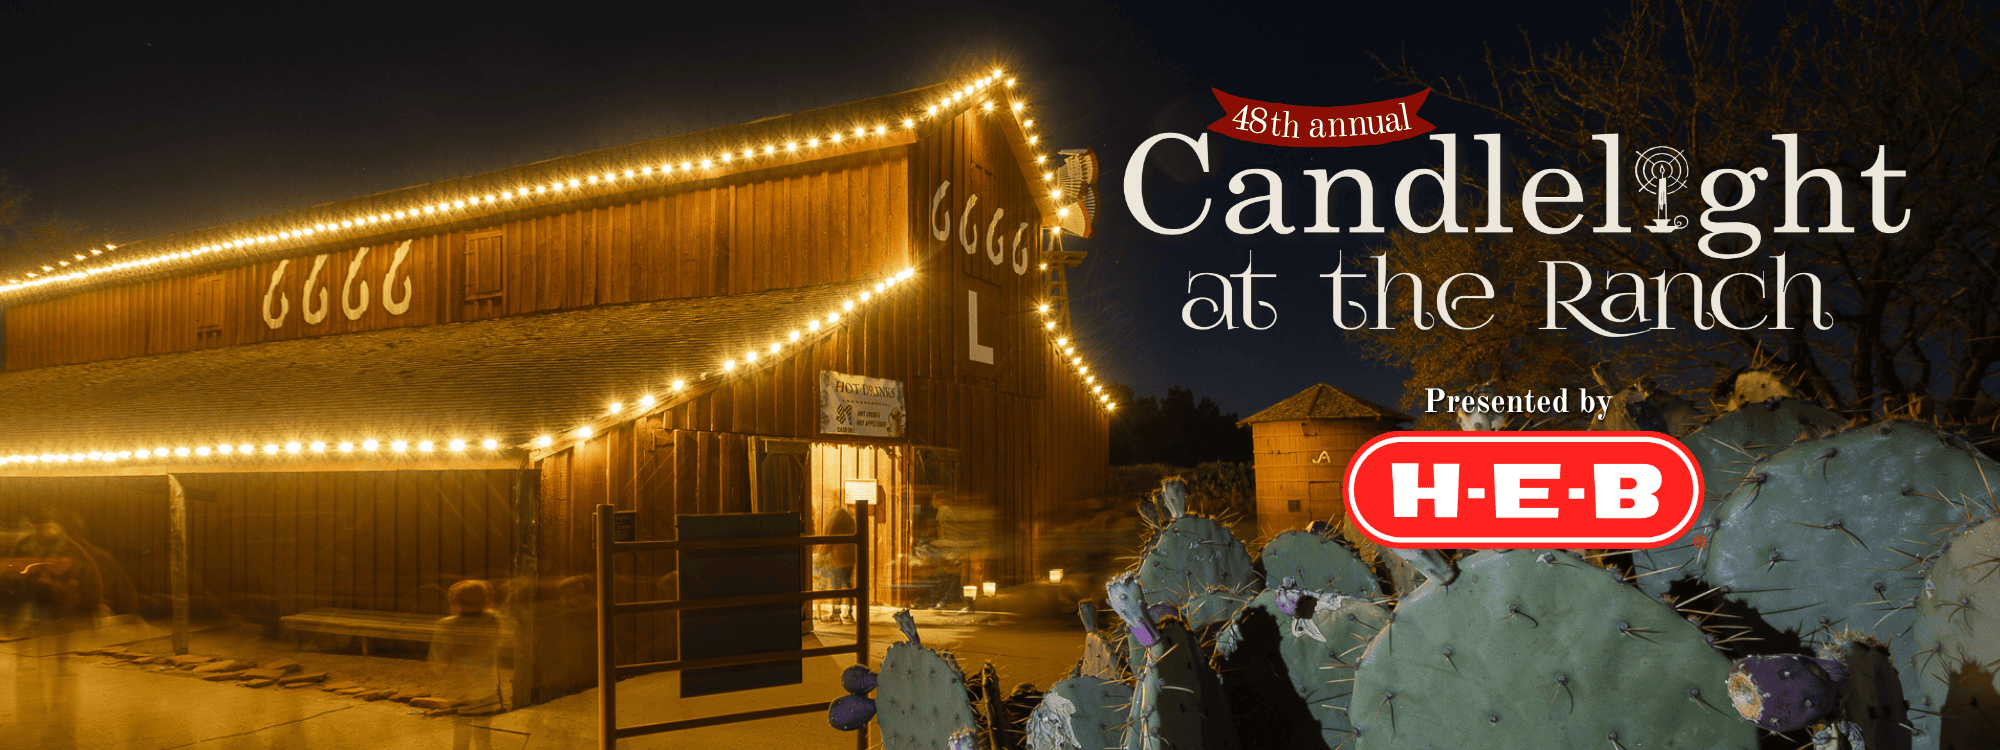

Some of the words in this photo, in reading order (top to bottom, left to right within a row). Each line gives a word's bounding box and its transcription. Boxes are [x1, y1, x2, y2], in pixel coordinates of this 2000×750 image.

[263, 239, 412, 329] 6666
[968, 289, 994, 365] L
[836, 381, 860, 394] HOT
[862, 384, 895, 398] DRINKS
